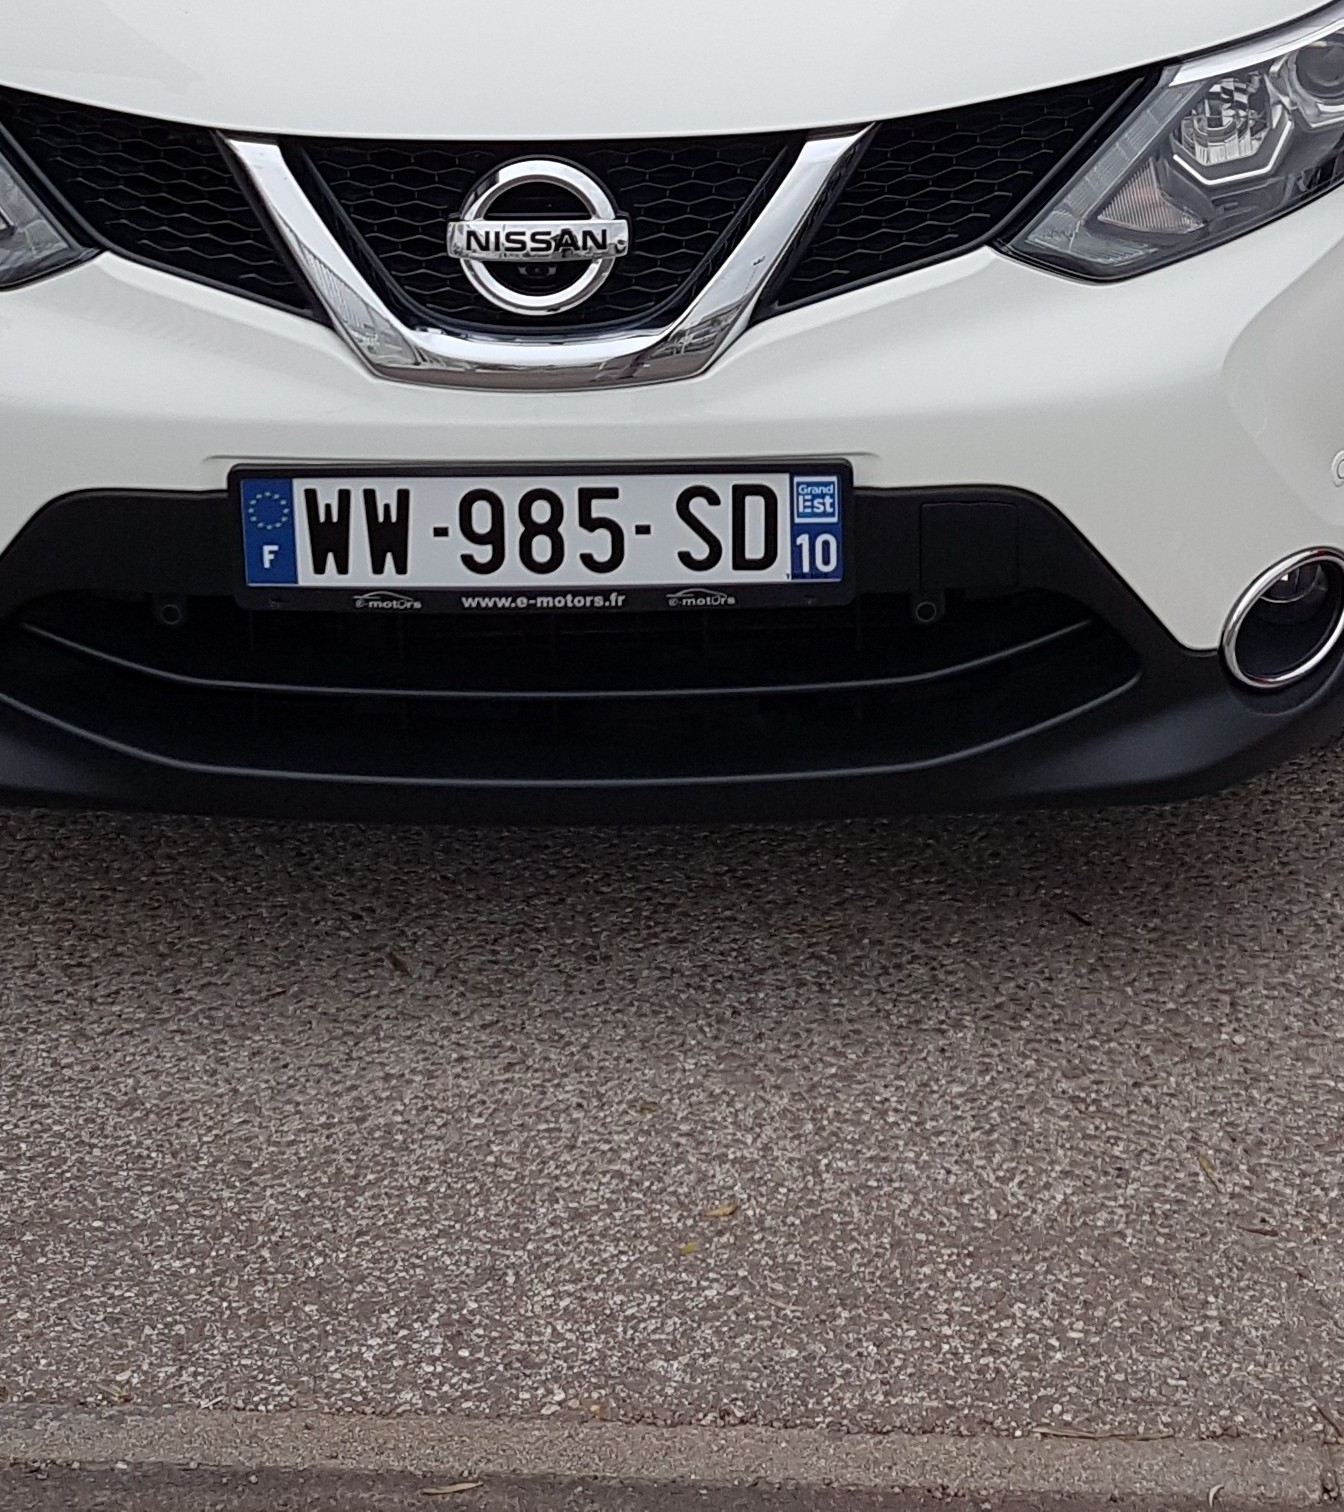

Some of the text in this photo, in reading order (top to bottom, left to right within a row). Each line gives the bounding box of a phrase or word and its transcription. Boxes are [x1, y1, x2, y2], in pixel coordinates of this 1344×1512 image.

[465, 228, 608, 253] NISSAN
[798, 484, 834, 495] Grand
[798, 495, 834, 513] Est
[262, 544, 279, 568] F
[796, 533, 838, 573] 10
[461, 592, 626, 608] www.e-motors.fr
